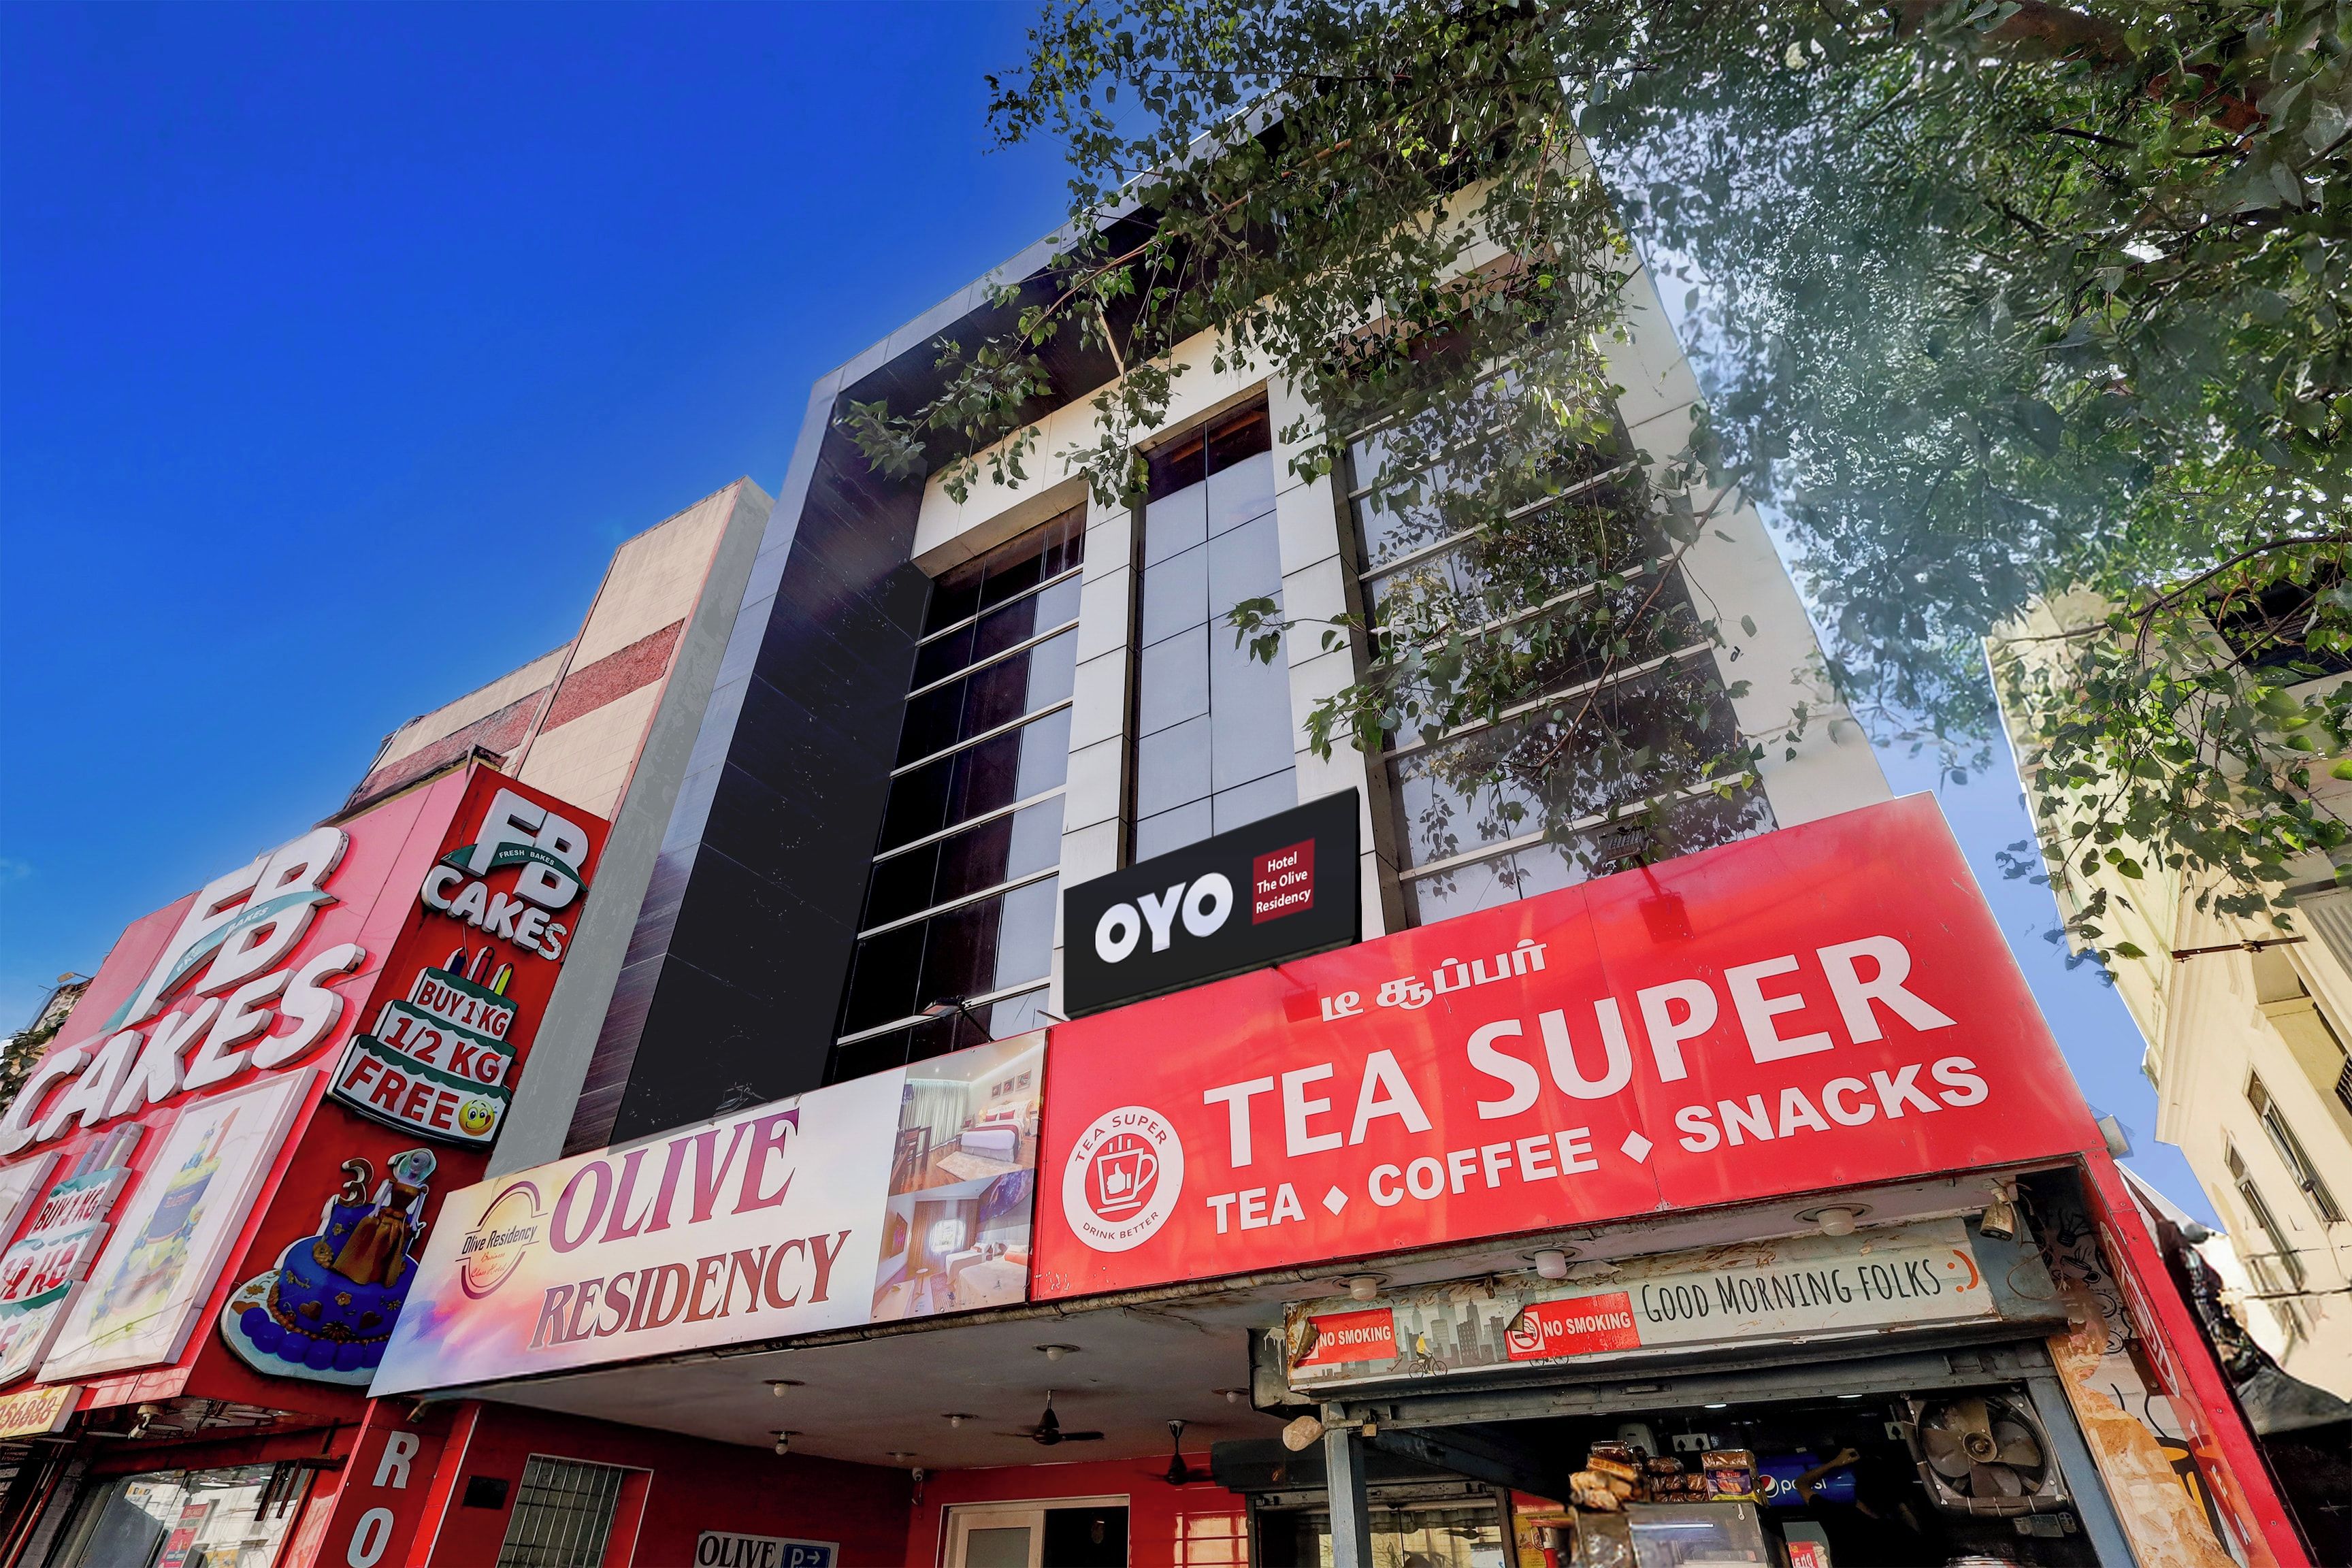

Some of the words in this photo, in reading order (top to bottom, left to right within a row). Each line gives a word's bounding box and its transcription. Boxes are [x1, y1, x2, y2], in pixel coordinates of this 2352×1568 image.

[466, 787, 589, 909] FB
[499, 849, 525, 859] FRESH
[529, 851, 555, 866] BAKES
[1268, 851, 1297, 872] Hotel
[1256, 879, 1277, 894] The
[1279, 870, 1308, 887] Olive
[1256, 889, 1311, 914] Residency
[118, 826, 350, 1031] FB
[421, 864, 568, 960] CAKES
[1095, 872, 1233, 963] OYO
[1375, 938, 1548, 1011] சூப்பர்
[417, 980, 465, 1017] BUY
[461, 1001, 476, 1024] 1
[477, 1006, 509, 1036] KG
[0, 943, 366, 1156] CAKES
[384, 1017, 442, 1064] 1/2
[447, 1041, 502, 1083] KG
[1204, 1049, 1432, 1169] TEA
[1467, 934, 1958, 1122] SUPER
[342, 1055, 460, 1130] FREE
[1075, 1127, 1106, 1162] TEA
[1112, 1114, 1167, 1145] SUPER
[1207, 1183, 1306, 1235] TEA
[1367, 1126, 1599, 1208] COFFEE
[1675, 1056, 1990, 1153] SNACKS
[549, 1107, 800, 1254] OLIVE
[461, 1235, 487, 1254] Olive
[487, 1226, 538, 1249] Residency
[1083, 1222, 1115, 1239] DRINK
[1120, 1211, 1158, 1239] BETTER
[481, 1252, 506, 1263] Business
[529, 1229, 852, 1349] RESIDENCY
[1642, 1284, 1710, 1323] GOOD
[1715, 1269, 1852, 1315] MORNING
[1858, 1258, 1942, 1302] FOLKS
[1320, 1332, 1335, 1348] NO
[1338, 1325, 1392, 1345] SMOKING
[1542, 1320, 1563, 1337] NO
[1566, 1311, 1631, 1335] SMOKING
[1781, 1478, 1827, 1494] psi
[698, 1535, 777, 1568] OLIVE
[791, 1548, 804, 1568] P
